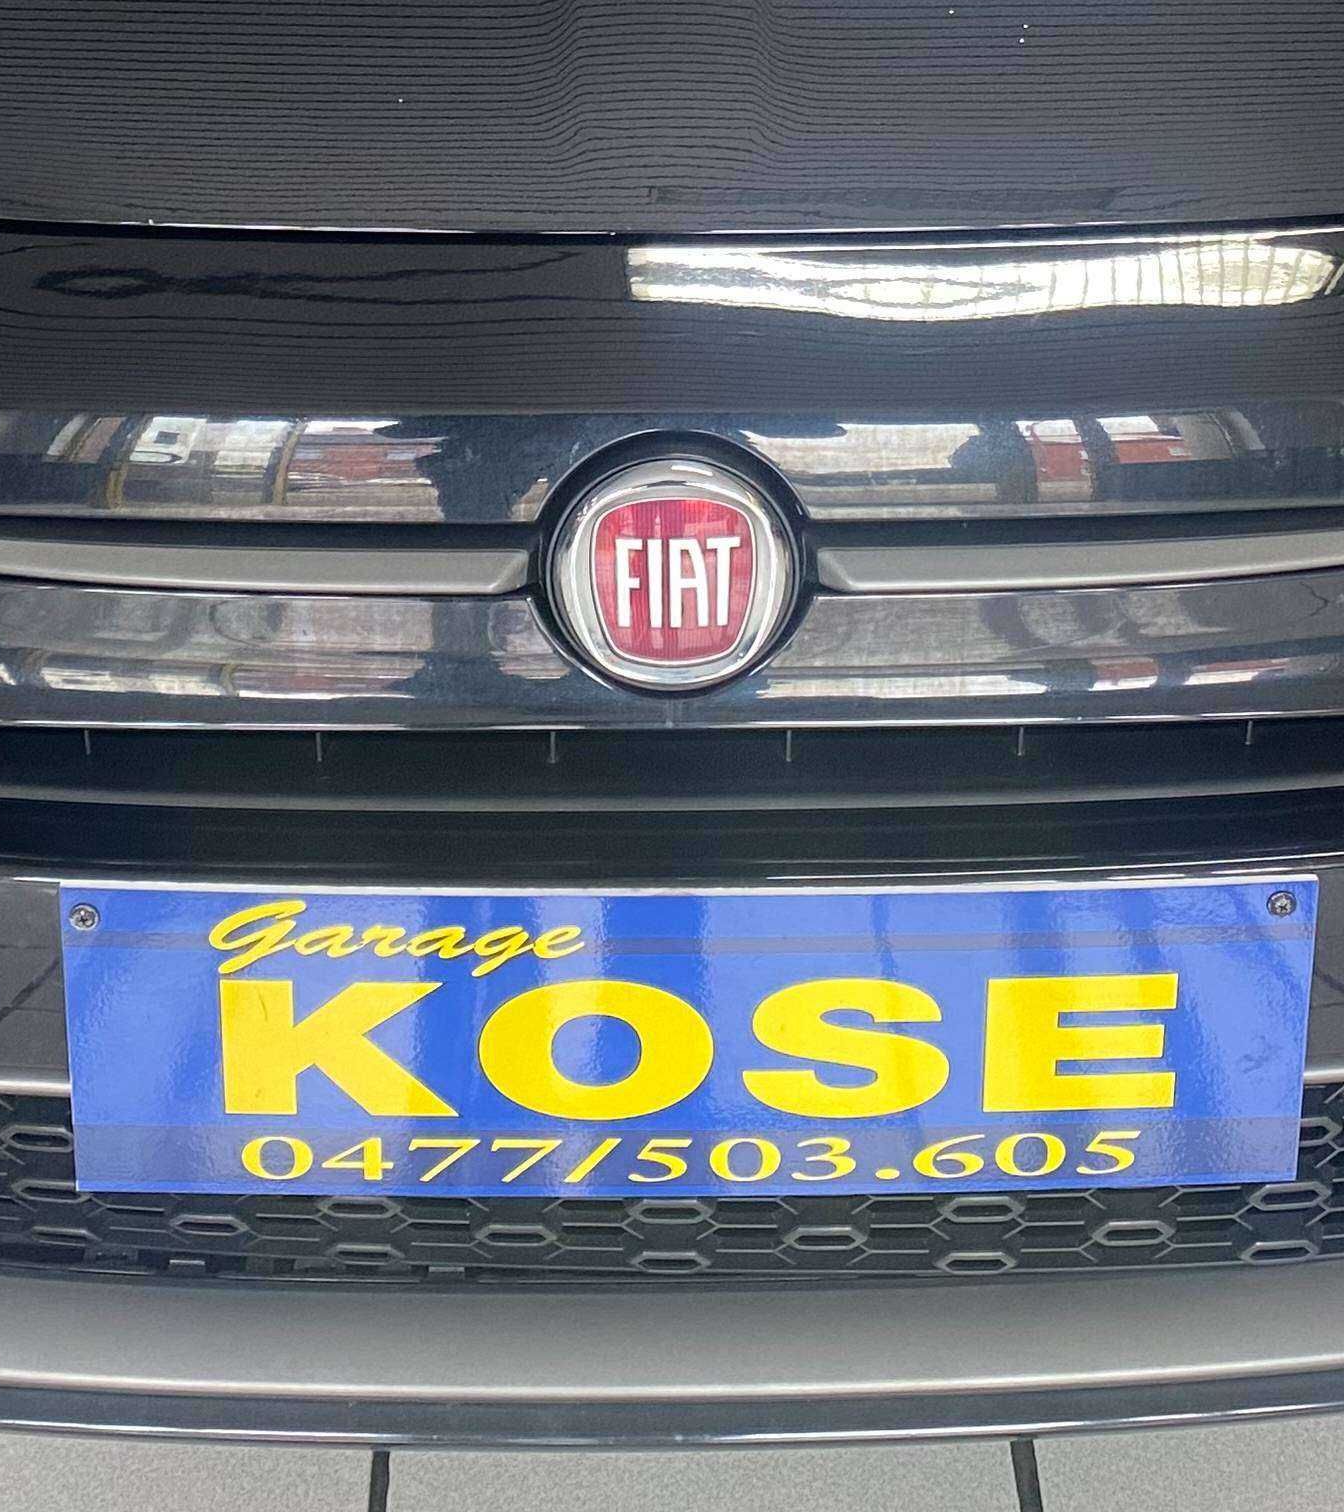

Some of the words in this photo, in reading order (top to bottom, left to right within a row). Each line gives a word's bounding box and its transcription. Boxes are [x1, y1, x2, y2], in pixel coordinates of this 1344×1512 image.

[614, 537, 741, 628] FIAT
[208, 899, 588, 978] Garage
[219, 973, 1179, 1120] KOSE
[241, 1131, 1142, 1185] 0477/503.605
